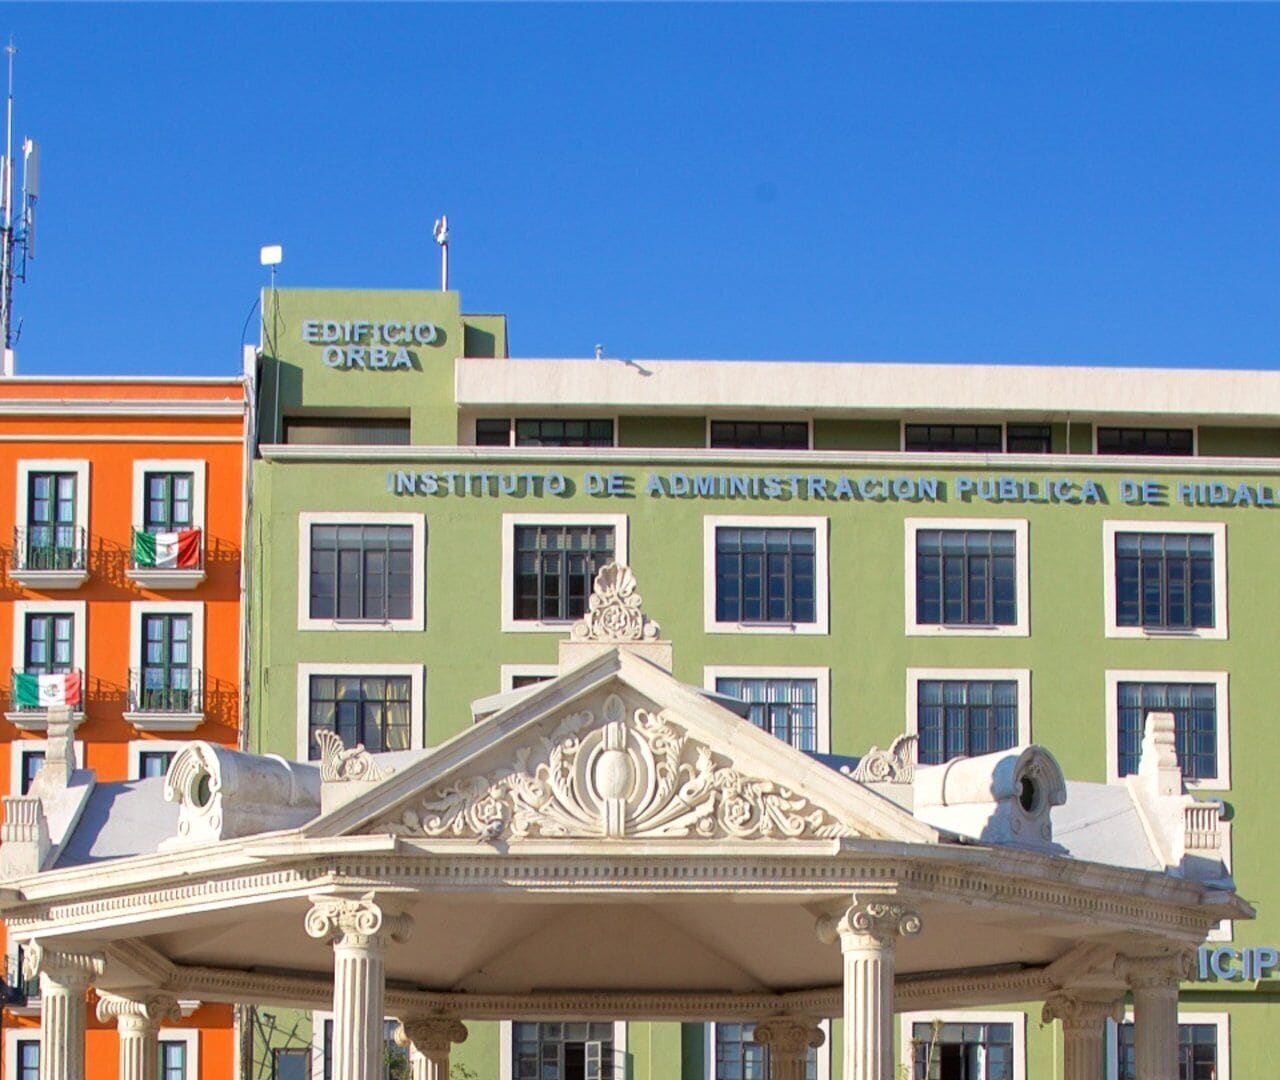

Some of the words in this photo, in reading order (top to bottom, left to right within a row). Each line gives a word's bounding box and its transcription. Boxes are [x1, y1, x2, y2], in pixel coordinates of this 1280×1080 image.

[302, 319, 436, 343] EDIFICIO
[322, 344, 412, 368] ORBA
[386, 471, 566, 495] INSTITUTO
[584, 472, 624, 495] DE
[645, 472, 939, 499] ADMINISTRACION
[955, 477, 1102, 501] PUBLICA
[1120, 480, 1164, 502] DE
